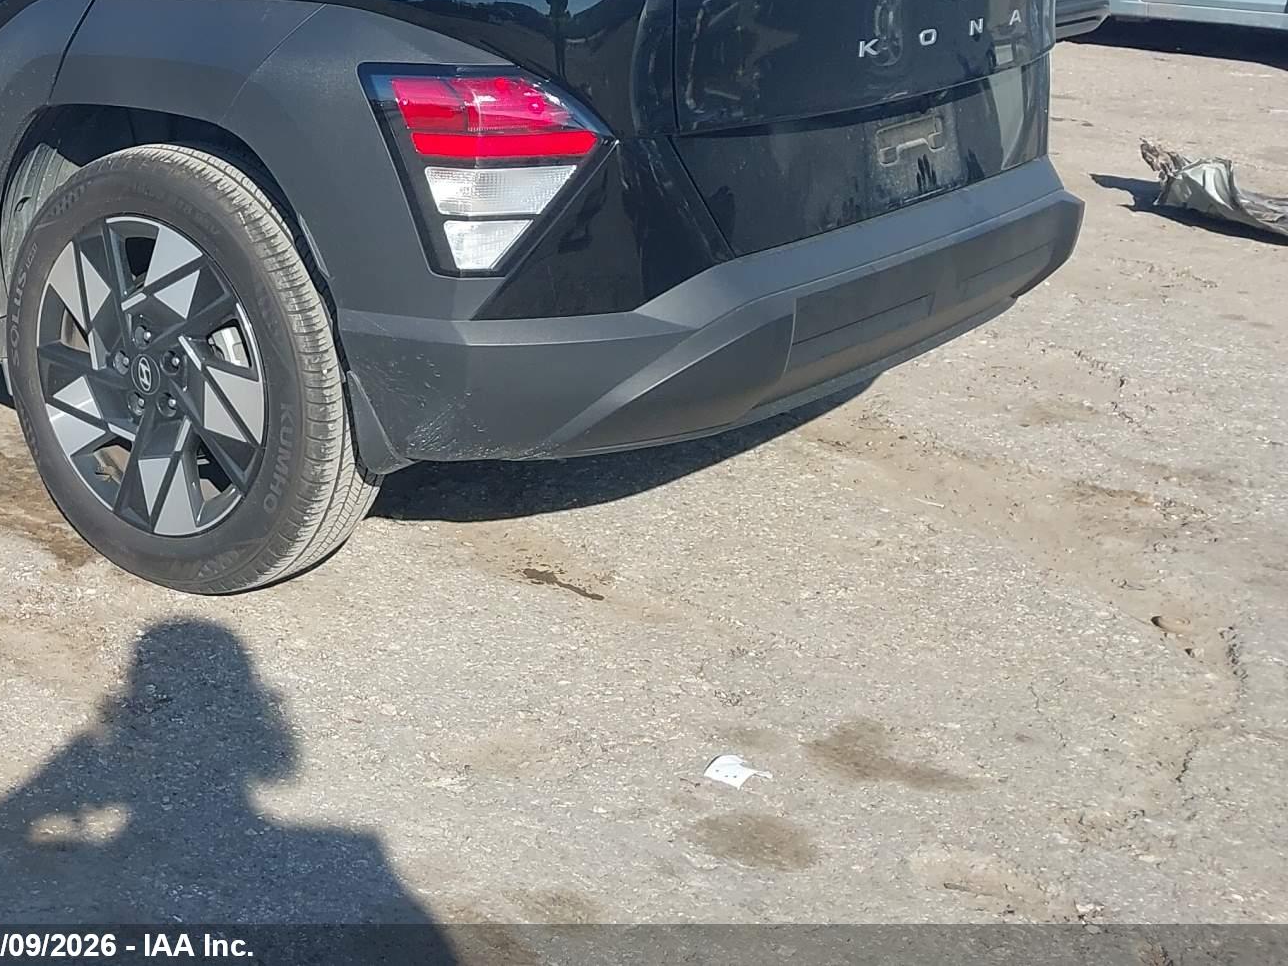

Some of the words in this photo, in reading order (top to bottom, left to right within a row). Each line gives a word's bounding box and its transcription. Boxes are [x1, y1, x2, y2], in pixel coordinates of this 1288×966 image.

[857, 8, 1023, 59] KONA
[10, 266, 28, 368] SOLUS
[262, 402, 296, 515] KUMHO
